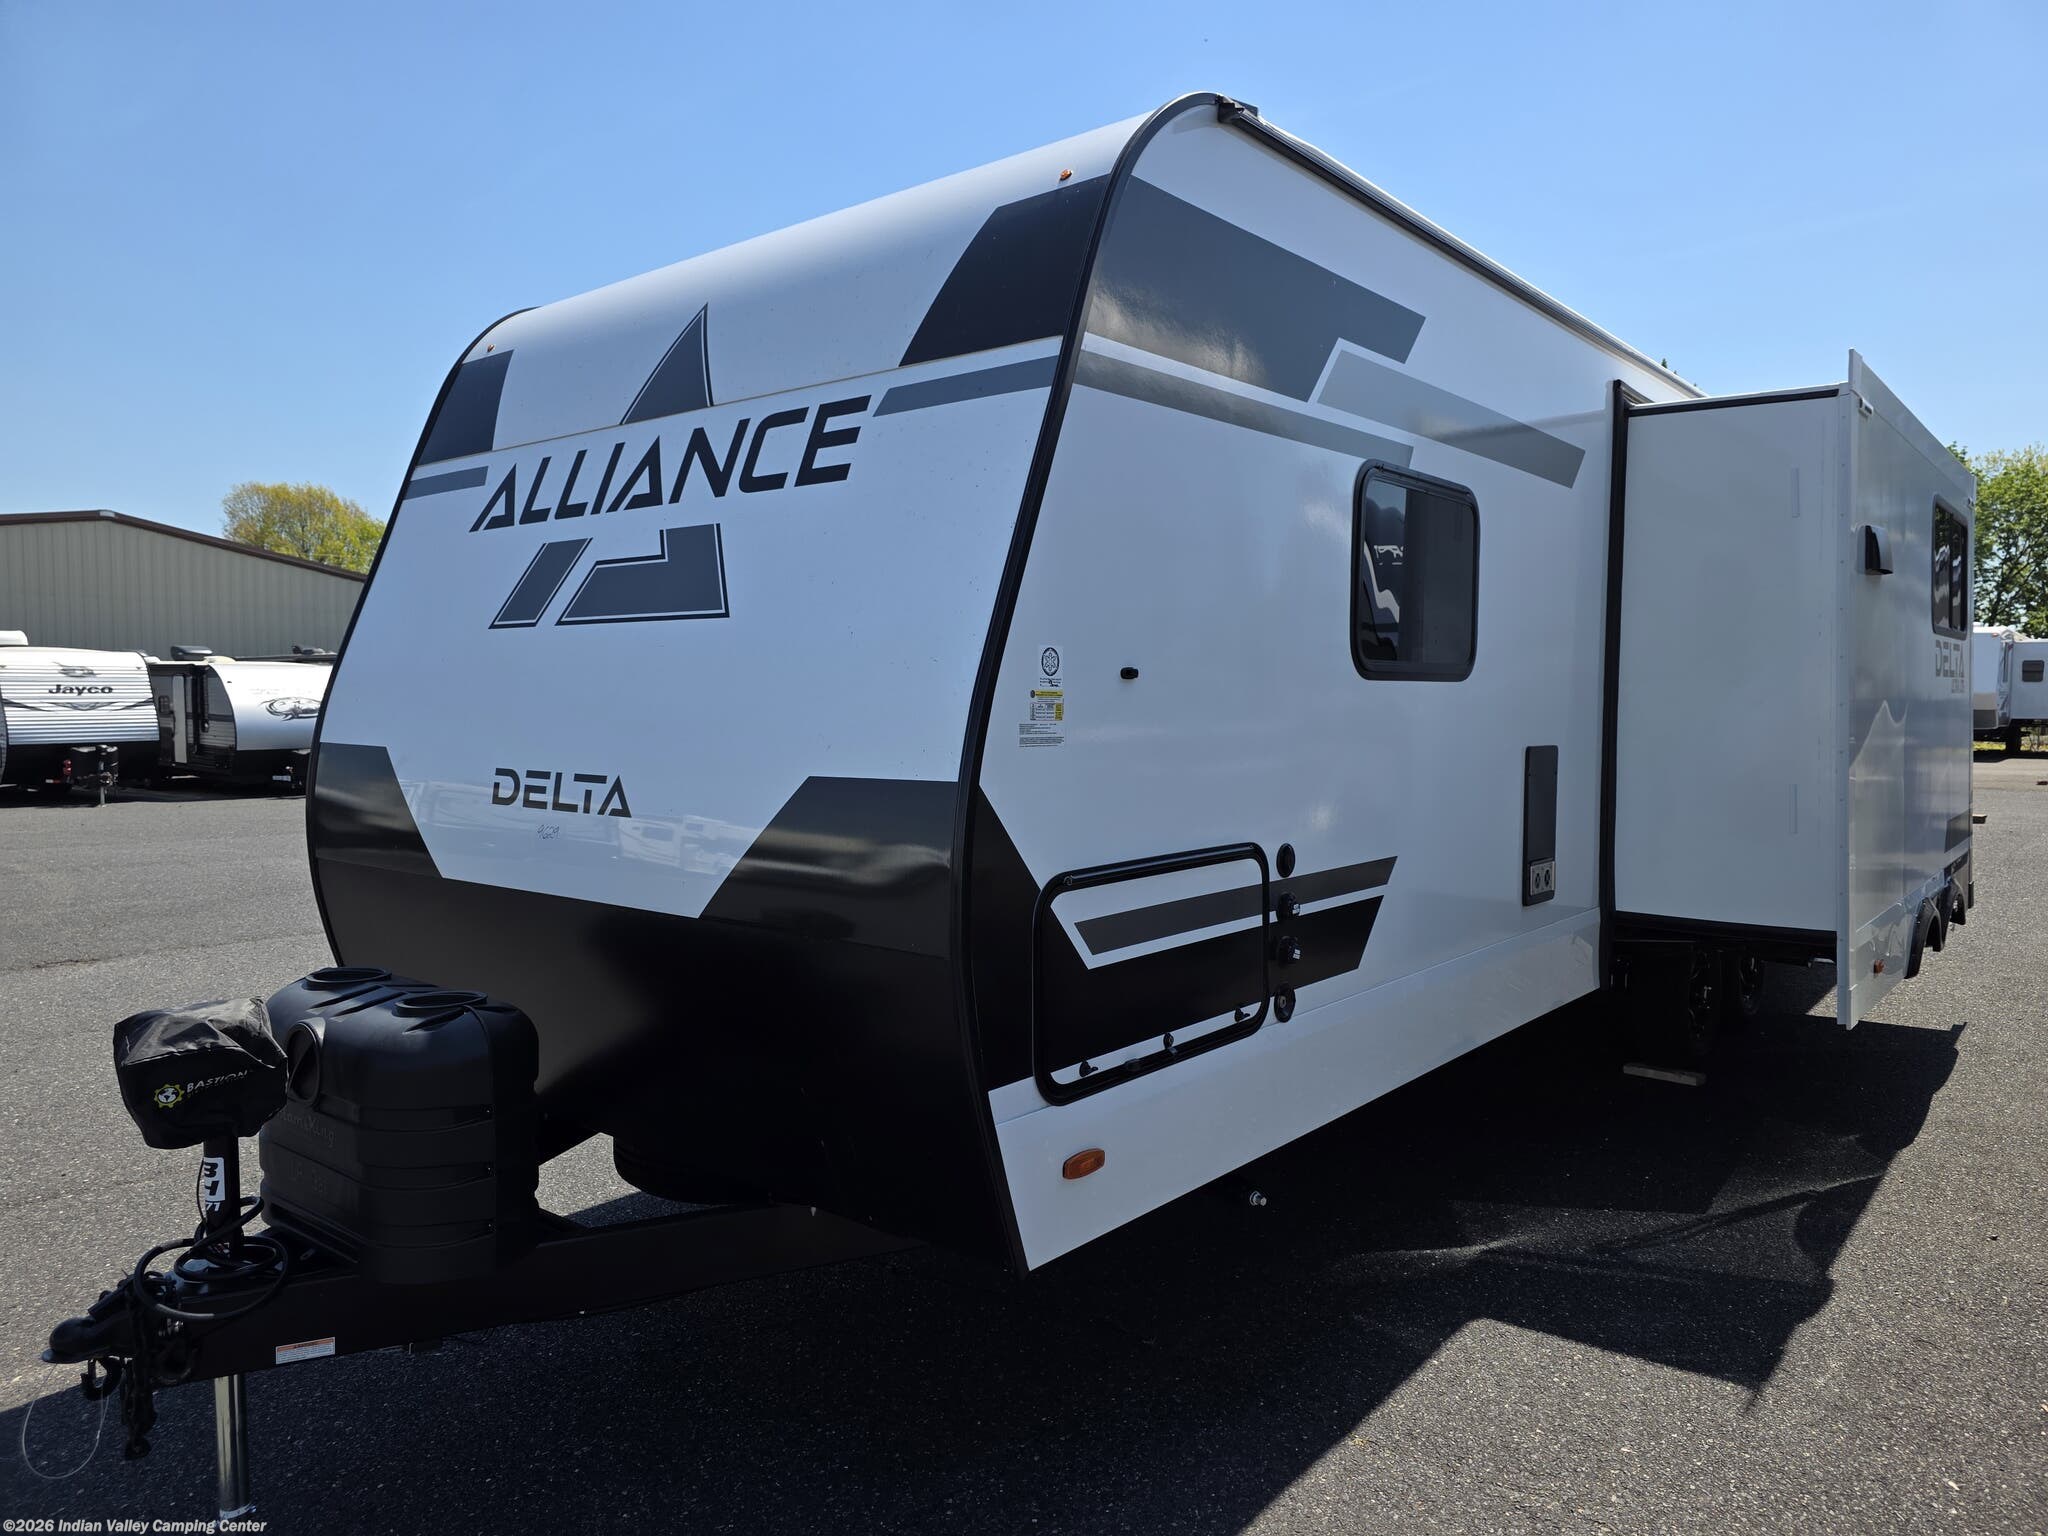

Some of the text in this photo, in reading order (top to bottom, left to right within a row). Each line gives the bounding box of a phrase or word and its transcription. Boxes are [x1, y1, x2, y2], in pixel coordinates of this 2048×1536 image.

[469, 395, 871, 532] ALLIANCE
[1935, 640, 1965, 678] DELTA
[48, 684, 114, 696] Jayco
[491, 767, 633, 818] DELTA
